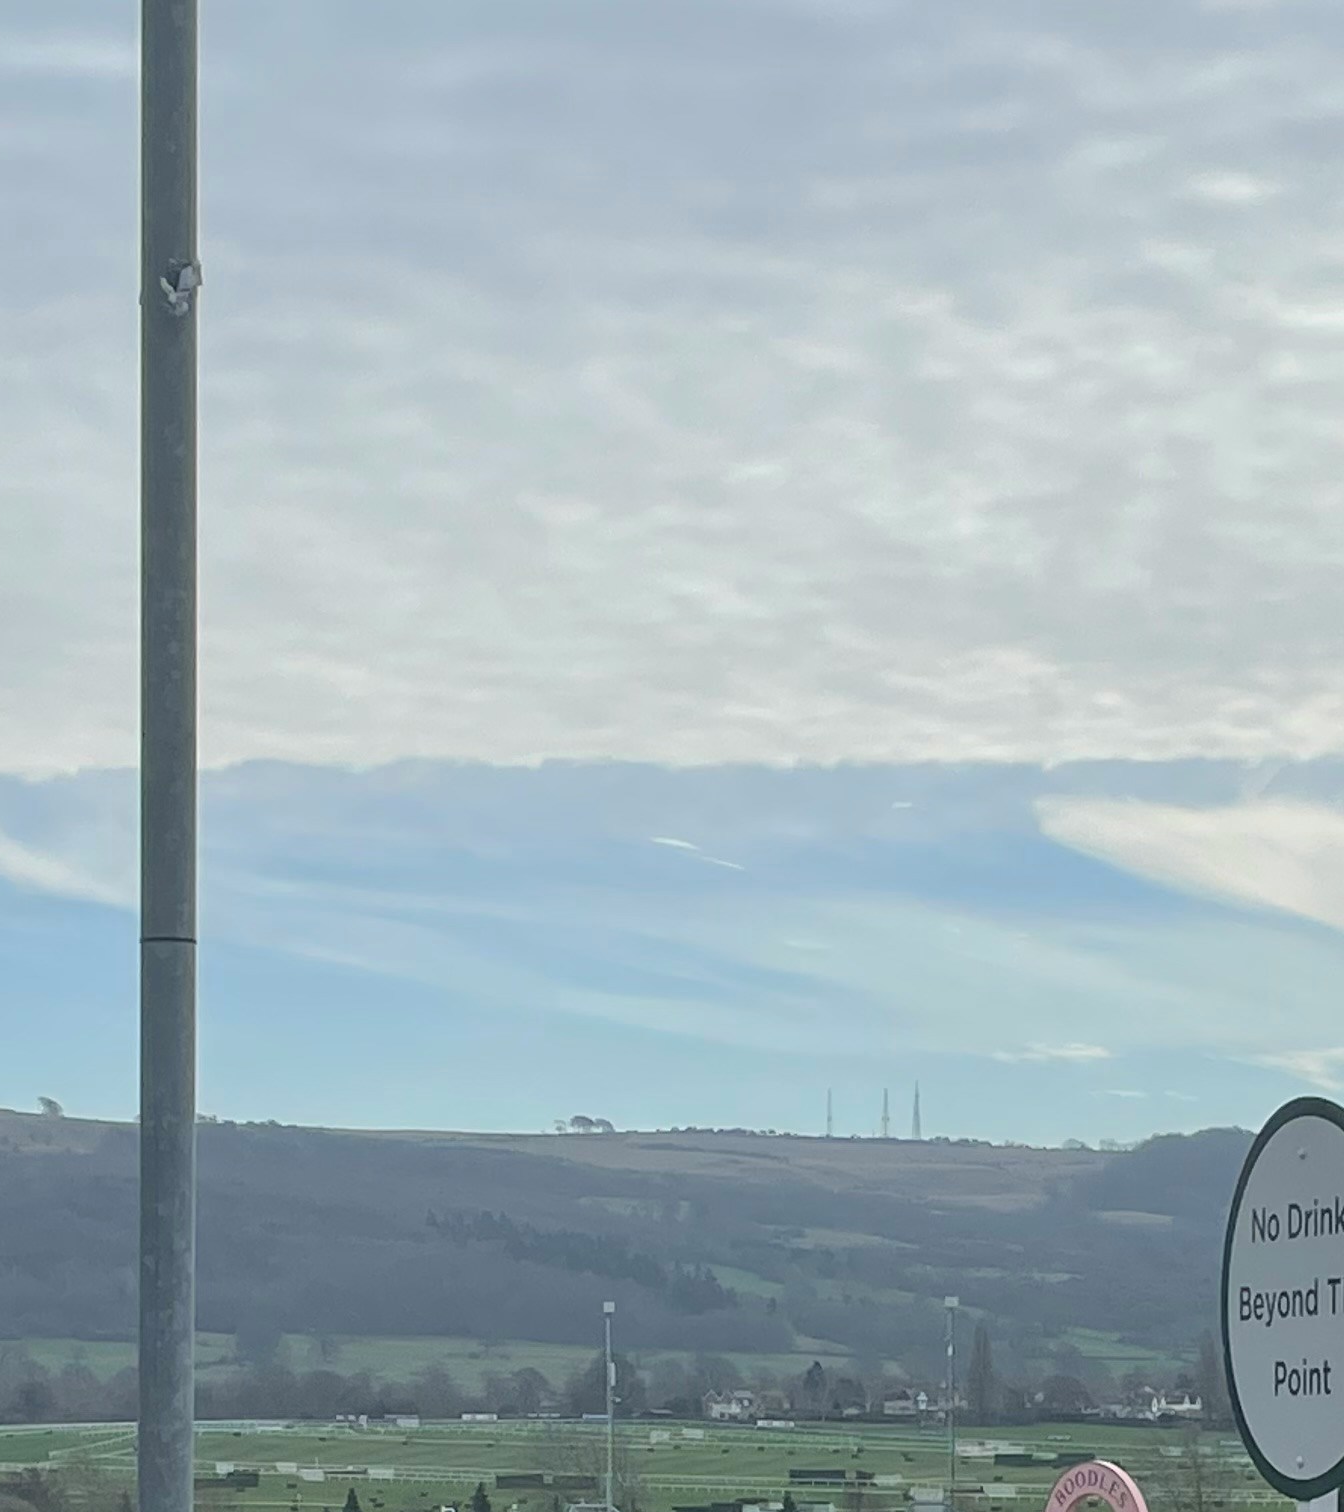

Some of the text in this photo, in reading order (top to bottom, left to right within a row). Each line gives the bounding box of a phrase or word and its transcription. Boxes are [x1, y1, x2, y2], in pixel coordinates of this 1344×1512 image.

[1251, 1207, 1280, 1243] No
[1239, 1278, 1319, 1328] Beyond
[1274, 1357, 1332, 1397] Point
[1055, 1468, 1128, 1509] BOODLES
